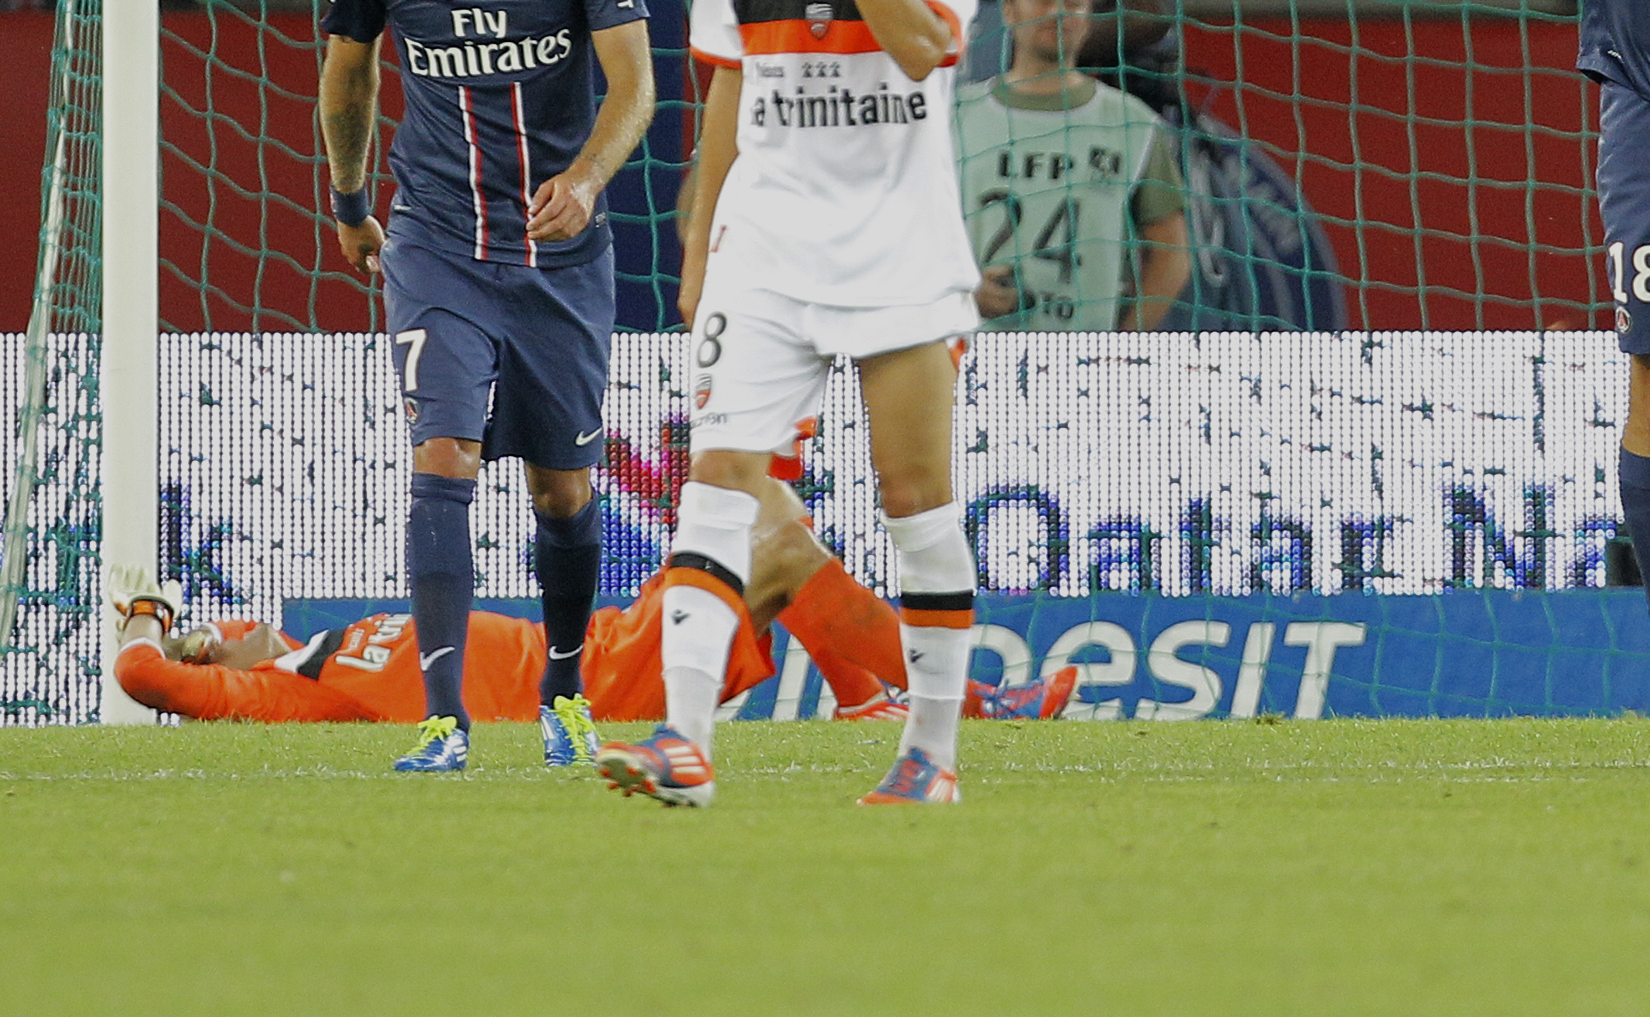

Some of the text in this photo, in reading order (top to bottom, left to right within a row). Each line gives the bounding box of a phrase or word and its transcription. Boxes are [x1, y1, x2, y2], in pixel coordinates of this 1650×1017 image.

[450, 6, 508, 38] Fly
[404, 27, 573, 78] Emirates
[772, 82, 928, 128] trinitaine
[999, 150, 1075, 180] LFP
[975, 186, 1084, 285] 24
[395, 329, 427, 392] 7
[964, 481, 1388, 595] Qatar
